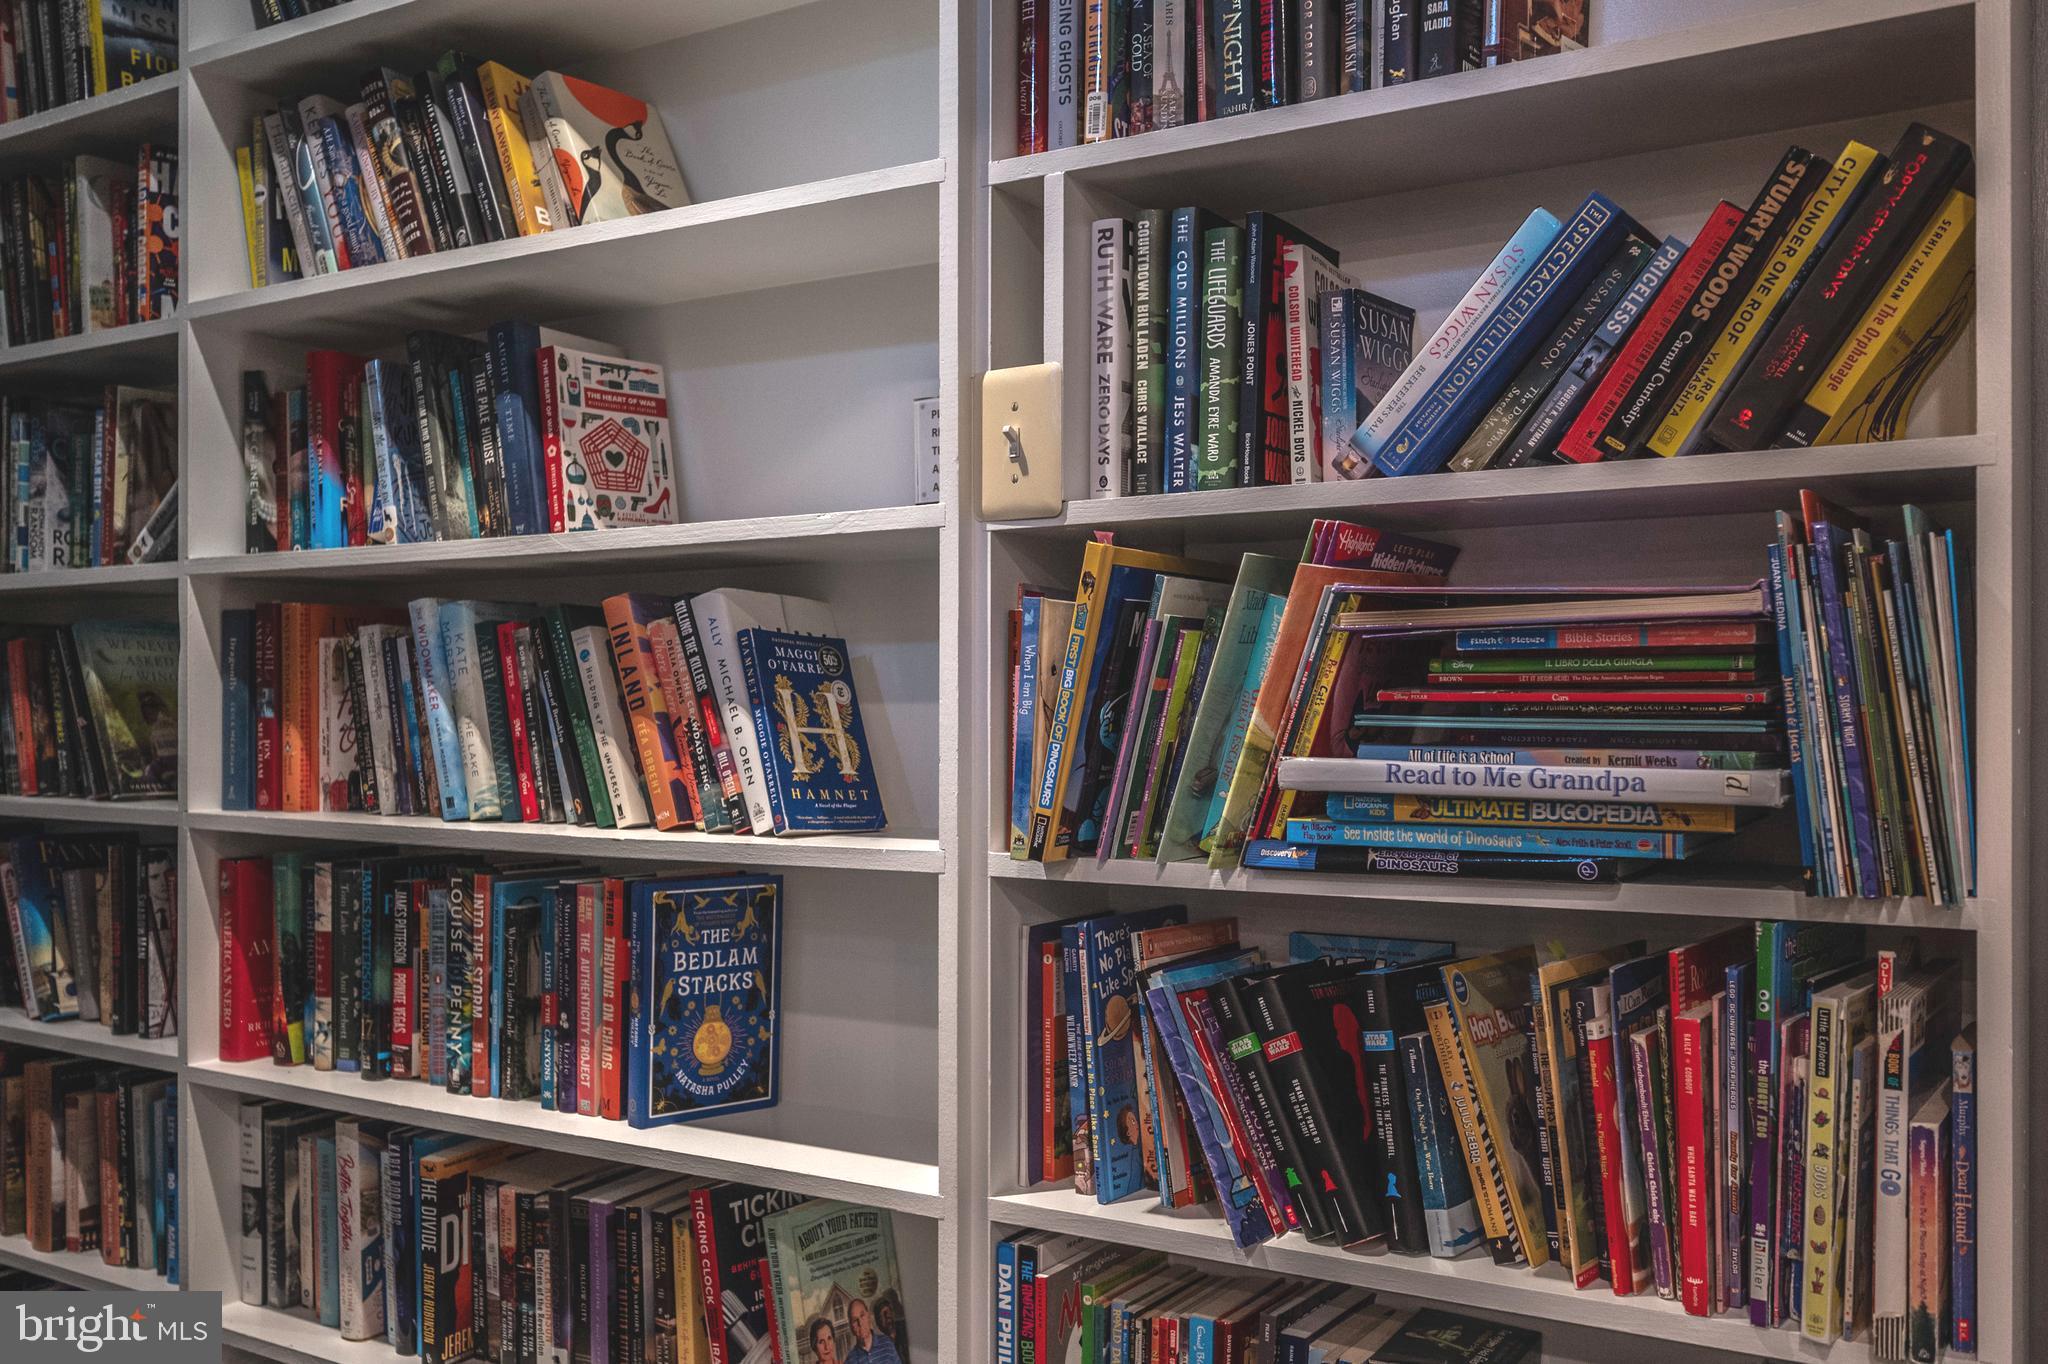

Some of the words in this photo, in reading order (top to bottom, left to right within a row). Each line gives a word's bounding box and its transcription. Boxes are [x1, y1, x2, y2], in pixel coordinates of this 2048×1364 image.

[1423, 16, 1452, 32] VLADIC
[1426, 1, 1448, 15] SARA
[1132, 34, 1142, 72] GOLD
[1222, 11, 1243, 96] NIGHT
[1059, 41, 1072, 106] GHOSTS
[1222, 102, 1248, 116] TAHIR
[303, 106, 326, 178] KEPNES
[485, 87, 499, 121] JENNY
[495, 123, 513, 172] LAWSON
[1825, 155, 1856, 196] CITY
[511, 178, 525, 221] BROKEN
[1745, 160, 1803, 240] STUART
[1177, 215, 1188, 242] THE
[1784, 198, 1828, 259] UNDER
[1921, 218, 1950, 258] SERHIY
[1096, 226, 1114, 299] RUTH
[1176, 250, 1188, 290] COLD
[1210, 239, 1226, 264] THE
[1517, 220, 1587, 312] SPECTACLE
[1475, 243, 1523, 303] SUSAN
[1584, 268, 1621, 315] SUSAN
[1607, 244, 1676, 334] PRICELESS
[1693, 242, 1749, 320] WOODS
[1757, 261, 1786, 297] ONE
[1890, 257, 1922, 301] ZHADAN
[1206, 268, 1227, 350] LIFEGUARDS
[1288, 285, 1300, 321] COLSON
[1725, 298, 1760, 344] ROOF
[1873, 301, 1896, 326] The
[1095, 304, 1114, 365] WARE
[1175, 296, 1187, 369] MILLIONS
[1247, 320, 1255, 355] JONES
[1359, 306, 1411, 347] SUSAN
[1429, 303, 1475, 360] WIGGS
[1541, 315, 1583, 369] WILSON
[1289, 324, 1303, 382] WHITEHEAD
[1359, 335, 1411, 372] WIGGS
[1443, 322, 1504, 399] ILLUSION
[1660, 330, 1693, 372] Carnal
[1827, 325, 1878, 394] Orphanage
[474, 372, 486, 388] THE
[1209, 357, 1221, 403] AMANDA
[1246, 357, 1255, 386] POINT
[1670, 349, 1719, 419] YAMASHITA
[1695, 377, 1714, 402] IRIS
[478, 394, 490, 421] PALE
[586, 391, 601, 399] THE
[602, 394, 626, 402] HEART
[639, 399, 656, 407] WAR
[1136, 379, 1147, 411] CHRIS
[1174, 396, 1185, 426] JESS
[1620, 372, 1664, 427] Curiosity
[1207, 407, 1220, 434] EYRE
[1292, 400, 1304, 434] NICKEL
[482, 426, 494, 466] HOUSE
[1136, 413, 1147, 464] WALLACE
[1207, 436, 1220, 462] WARD
[1294, 437, 1305, 463] BOYS
[250, 447, 258, 496] CHANEL
[1173, 433, 1185, 488] WALTER
[1339, 529, 1376, 556] Highlights
[1771, 557, 1783, 592] JUANA
[1774, 592, 1786, 632] MEDINA
[707, 617, 722, 649] ALLY
[1064, 635, 1084, 667] FIRST
[1565, 632, 1593, 643] Bible
[1595, 631, 1633, 643] Stories
[418, 624, 440, 712] WIDOWMAKER
[453, 632, 469, 676] KATE
[609, 621, 645, 712] INLAND
[665, 639, 677, 667] DELIA
[672, 668, 686, 705] OWENS
[740, 636, 758, 694] HAMNET
[1323, 658, 1338, 679] Pete
[1061, 668, 1075, 689] BIG
[1314, 685, 1329, 708] Cat's
[1552, 693, 1569, 702] Cars
[465, 712, 474, 739] THE
[717, 658, 740, 723] MICHAEL
[734, 728, 742, 741] B.
[739, 745, 756, 788] OREN
[1054, 690, 1072, 729] BOOK
[1840, 694, 1853, 723] STORMY
[256, 721, 265, 779] MEACHAM
[1052, 724, 1067, 743] OF
[1844, 725, 1857, 748] NIGHT
[468, 742, 480, 779] LAKE
[636, 721, 649, 746] TÉA
[644, 751, 661, 797] OBREHT
[1040, 743, 1062, 807] DINOSAURS
[1608, 755, 1644, 767] Kermit
[1646, 755, 1678, 767] Weeks
[791, 788, 869, 801] HAMNET
[1385, 763, 1446, 785] Read
[1453, 767, 1476, 785] to
[1484, 766, 1521, 788] Me
[1528, 767, 1647, 797] Grandpa
[1275, 803, 1288, 829] HARPER
[1429, 799, 1526, 820] ULTIMATE
[1531, 802, 1661, 823] BUGOPEDIA
[1261, 848, 1293, 858] Discovery
[1376, 860, 1459, 873] DINOSAURS
[450, 877, 462, 952] LOUISE
[473, 893, 485, 927] INTO
[223, 907, 232, 978] AMERICAN
[473, 933, 484, 962] THE
[701, 928, 732, 945] THE
[1095, 922, 1131, 951] There's
[603, 937, 616, 997] THRIVING
[672, 947, 759, 973] BEDLAM
[472, 966, 484, 1019] STORM
[678, 971, 753, 996] STACKS
[223, 982, 232, 1028] NERO
[450, 985, 462, 1055] PENNY
[603, 1000, 614, 1018] ON
[1818, 1009, 1831, 1034] Little
[601, 1023, 614, 1071] CHAOS
[1066, 1015, 1077, 1065] WILLOWWEEP
[1433, 1023, 1451, 1077] NORTHFIELD
[1817, 1036, 1830, 1078] Explorers
[674, 1069, 715, 1097] NATASHA
[717, 1058, 750, 1093] PULLEY
[1069, 1066, 1077, 1089] MANOR
[1535, 1086, 1545, 1120] Soccer
[1957, 1100, 1968, 1137] Murphy
[1454, 1095, 1471, 1128] JULIUS
[1464, 1129, 1480, 1164] ZEBRA
[1539, 1125, 1549, 1153] Team
[420, 1176, 438, 1202] THE
[1542, 1156, 1552, 1187] Upset
[1814, 1164, 1828, 1200] BUGS
[1956, 1162, 1969, 1190] Dear
[421, 1204, 438, 1254] DIVIDE
[694, 1198, 710, 1256] TICKING
[798, 1222, 824, 1251] ABOUT
[825, 1214, 848, 1235] YOUR
[849, 1212, 879, 1229] FATHER
[1955, 1190, 1973, 1244] Hound
[1021, 1261, 1033, 1282] THE
[1731, 1247, 1739, 1275] TAYLOR
[423, 1263, 436, 1300] JEREMY
[701, 1258, 715, 1306] CLOCK
[998, 1265, 1011, 1306] DAN
[422, 1301, 435, 1345] ROBINSON
